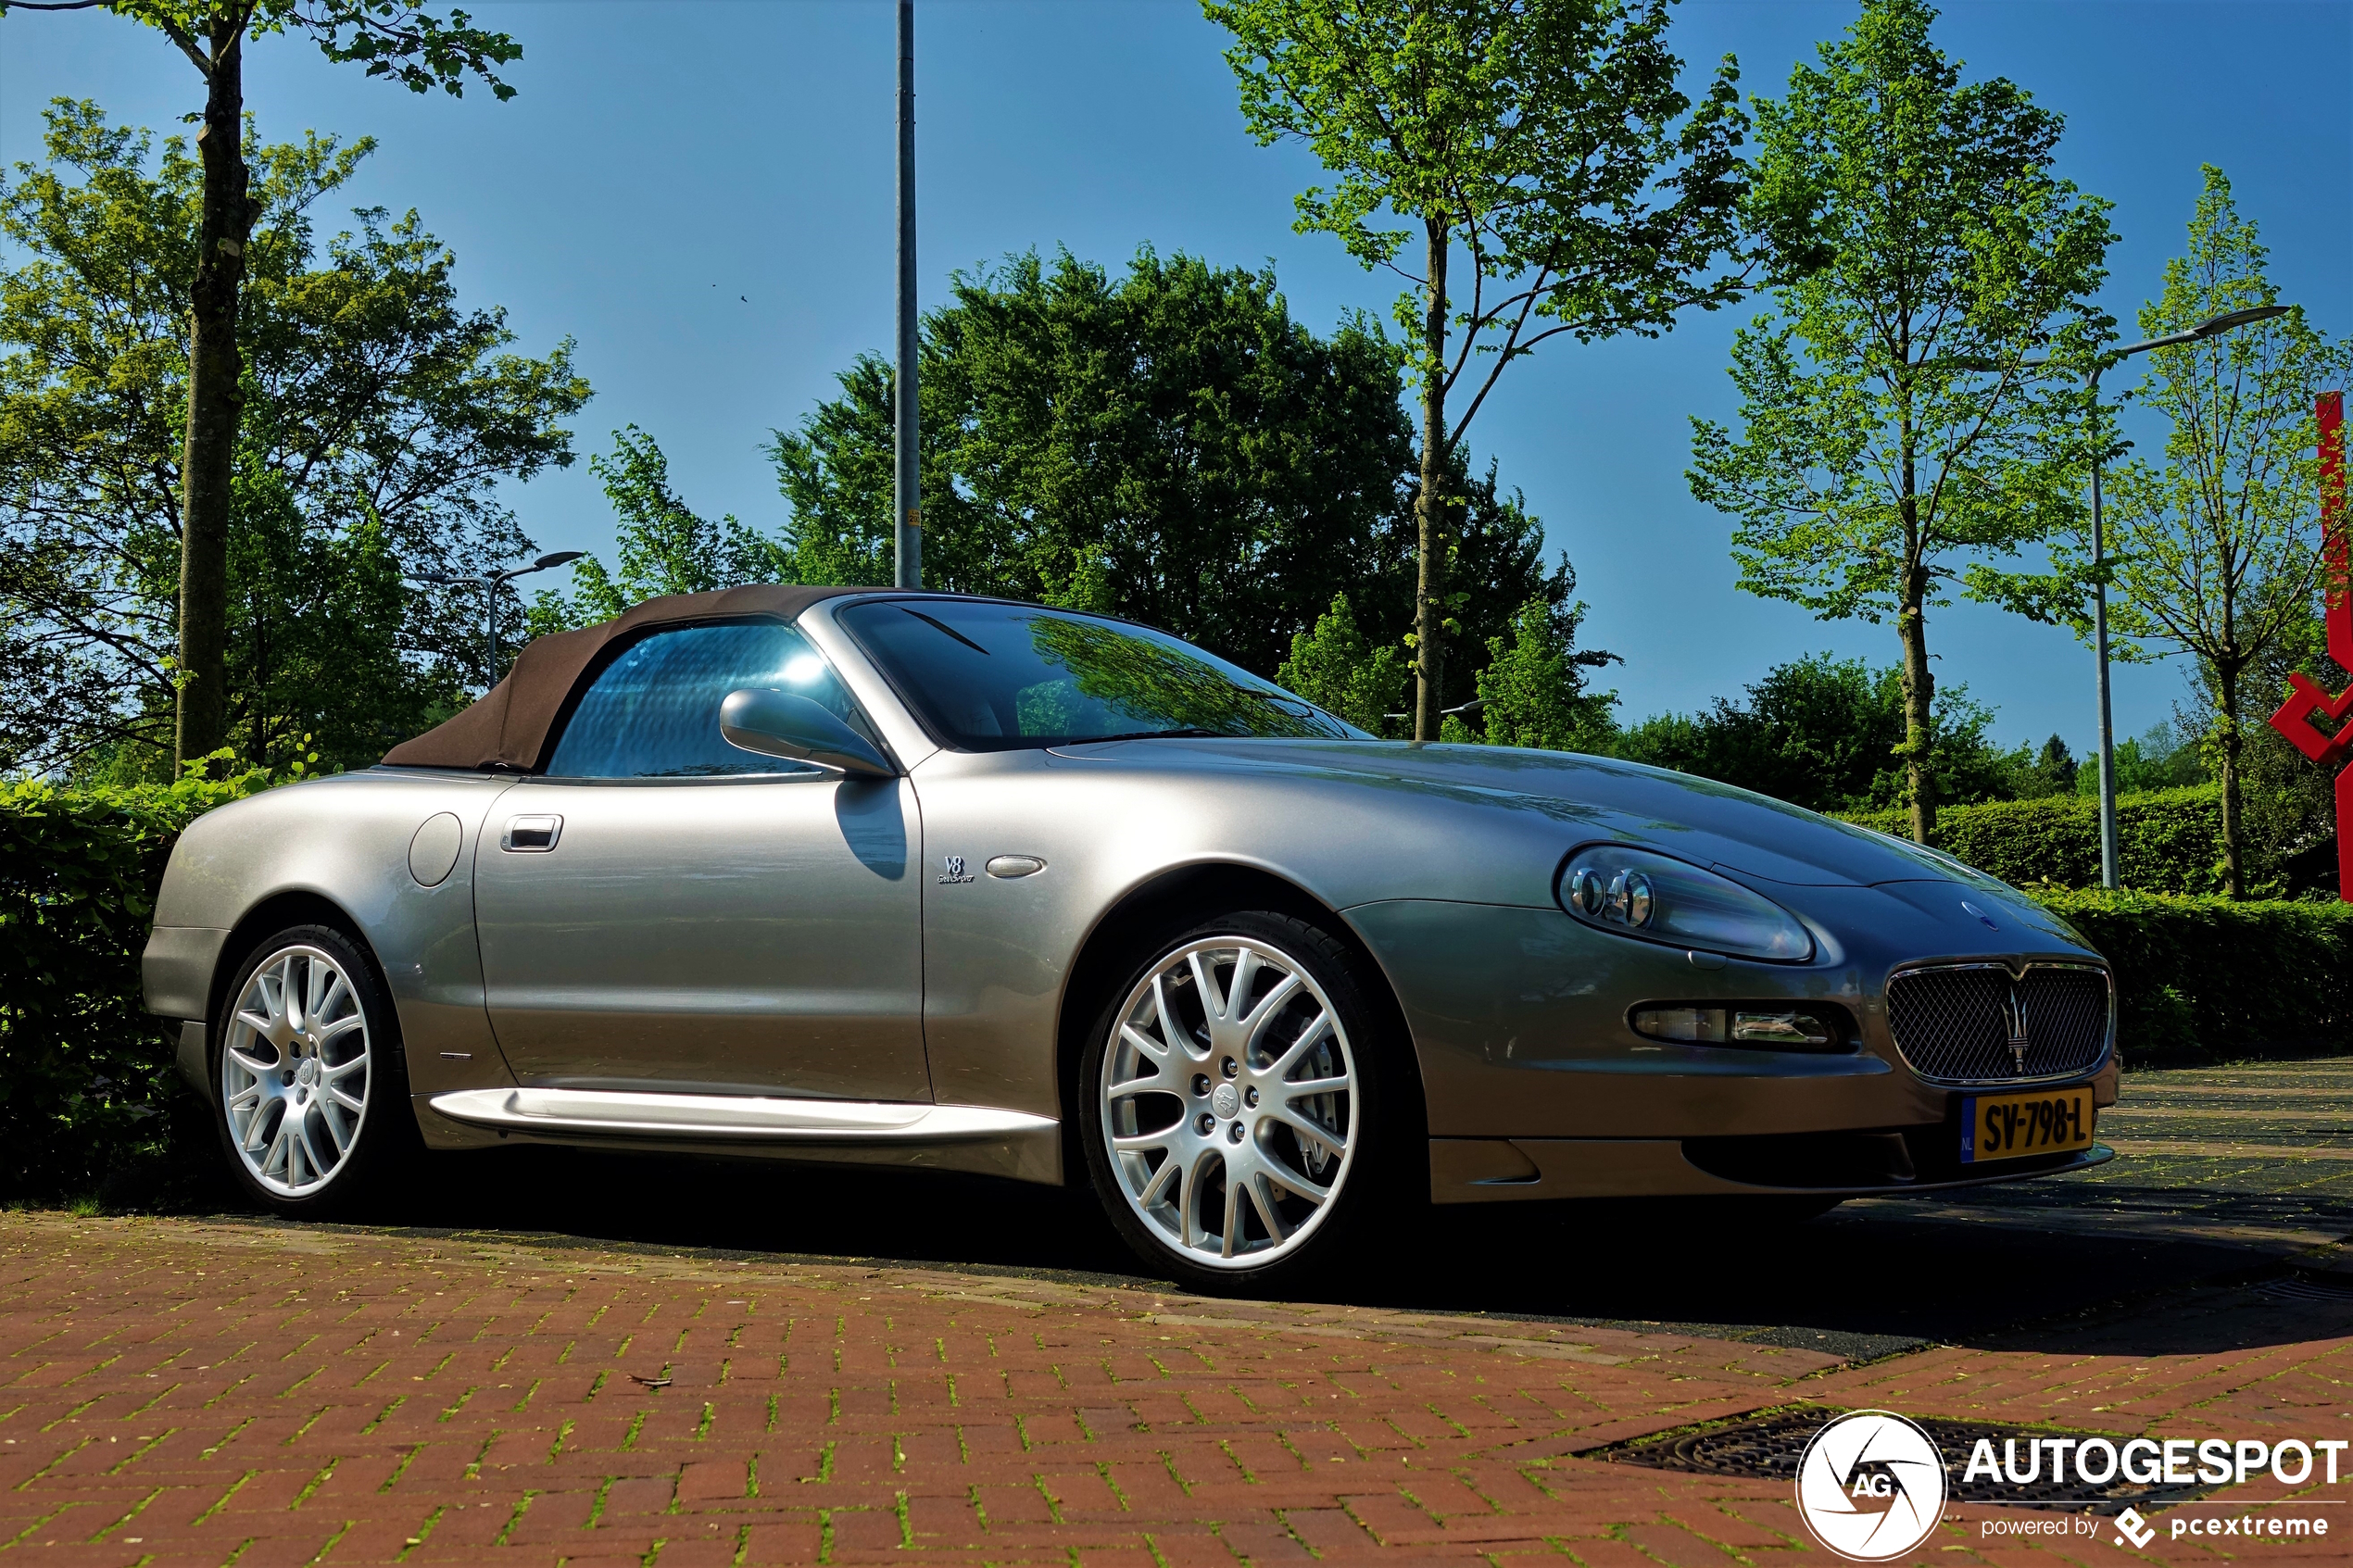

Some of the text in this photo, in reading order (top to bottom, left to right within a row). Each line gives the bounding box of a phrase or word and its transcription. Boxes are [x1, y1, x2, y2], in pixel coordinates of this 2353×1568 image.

[945, 856, 962, 873] V8
[1984, 1098, 2086, 1152] SV-798-L
[1961, 1137, 1973, 1151] NL
